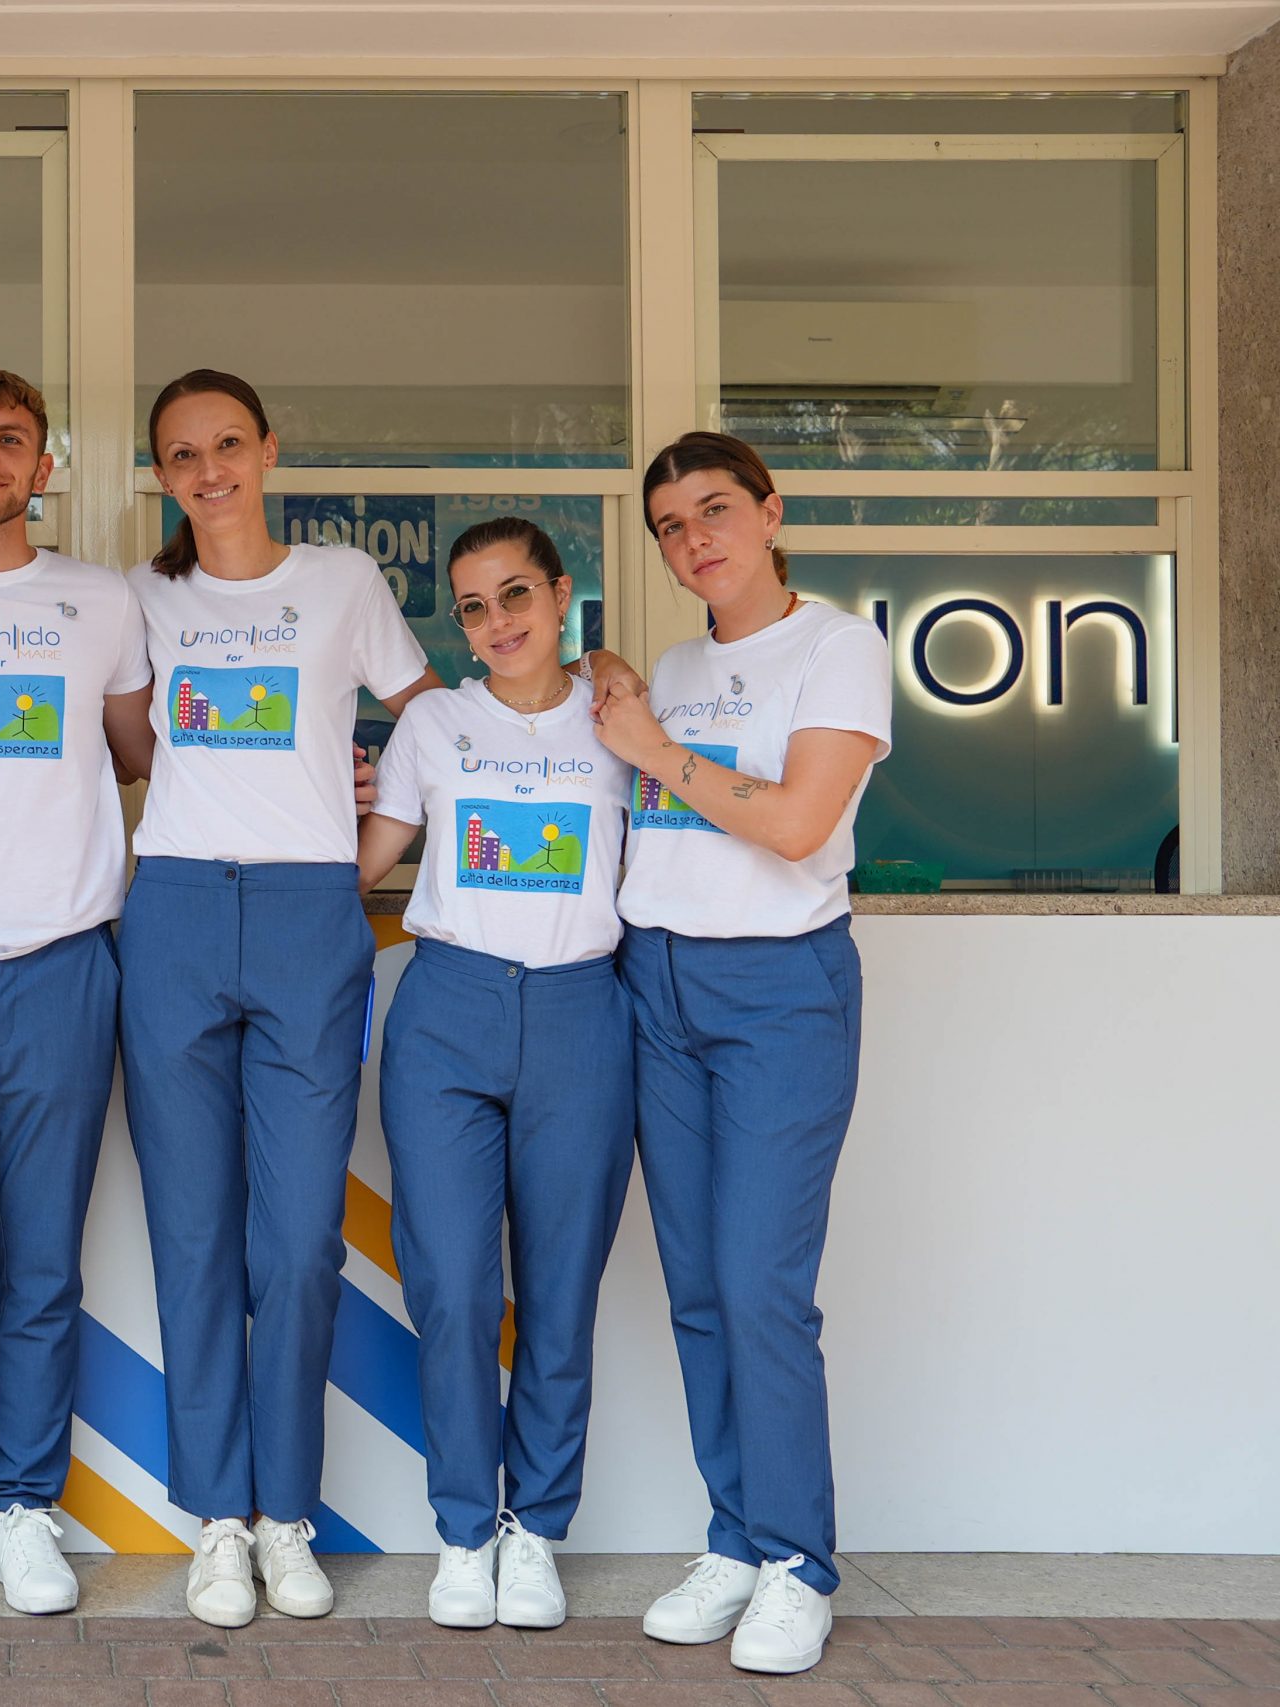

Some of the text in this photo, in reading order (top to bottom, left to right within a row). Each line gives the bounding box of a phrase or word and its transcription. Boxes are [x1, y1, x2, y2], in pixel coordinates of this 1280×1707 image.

[19, 649, 62, 661] MARE
[225, 653, 244, 663] for
[683, 727, 701, 737] for
[197, 733, 228, 745] della
[230, 735, 292, 747] speranza
[550, 775, 593, 788] MARE
[514, 784, 535, 795] for
[647, 812, 678, 825] della
[460, 872, 580, 890] città della speranza
